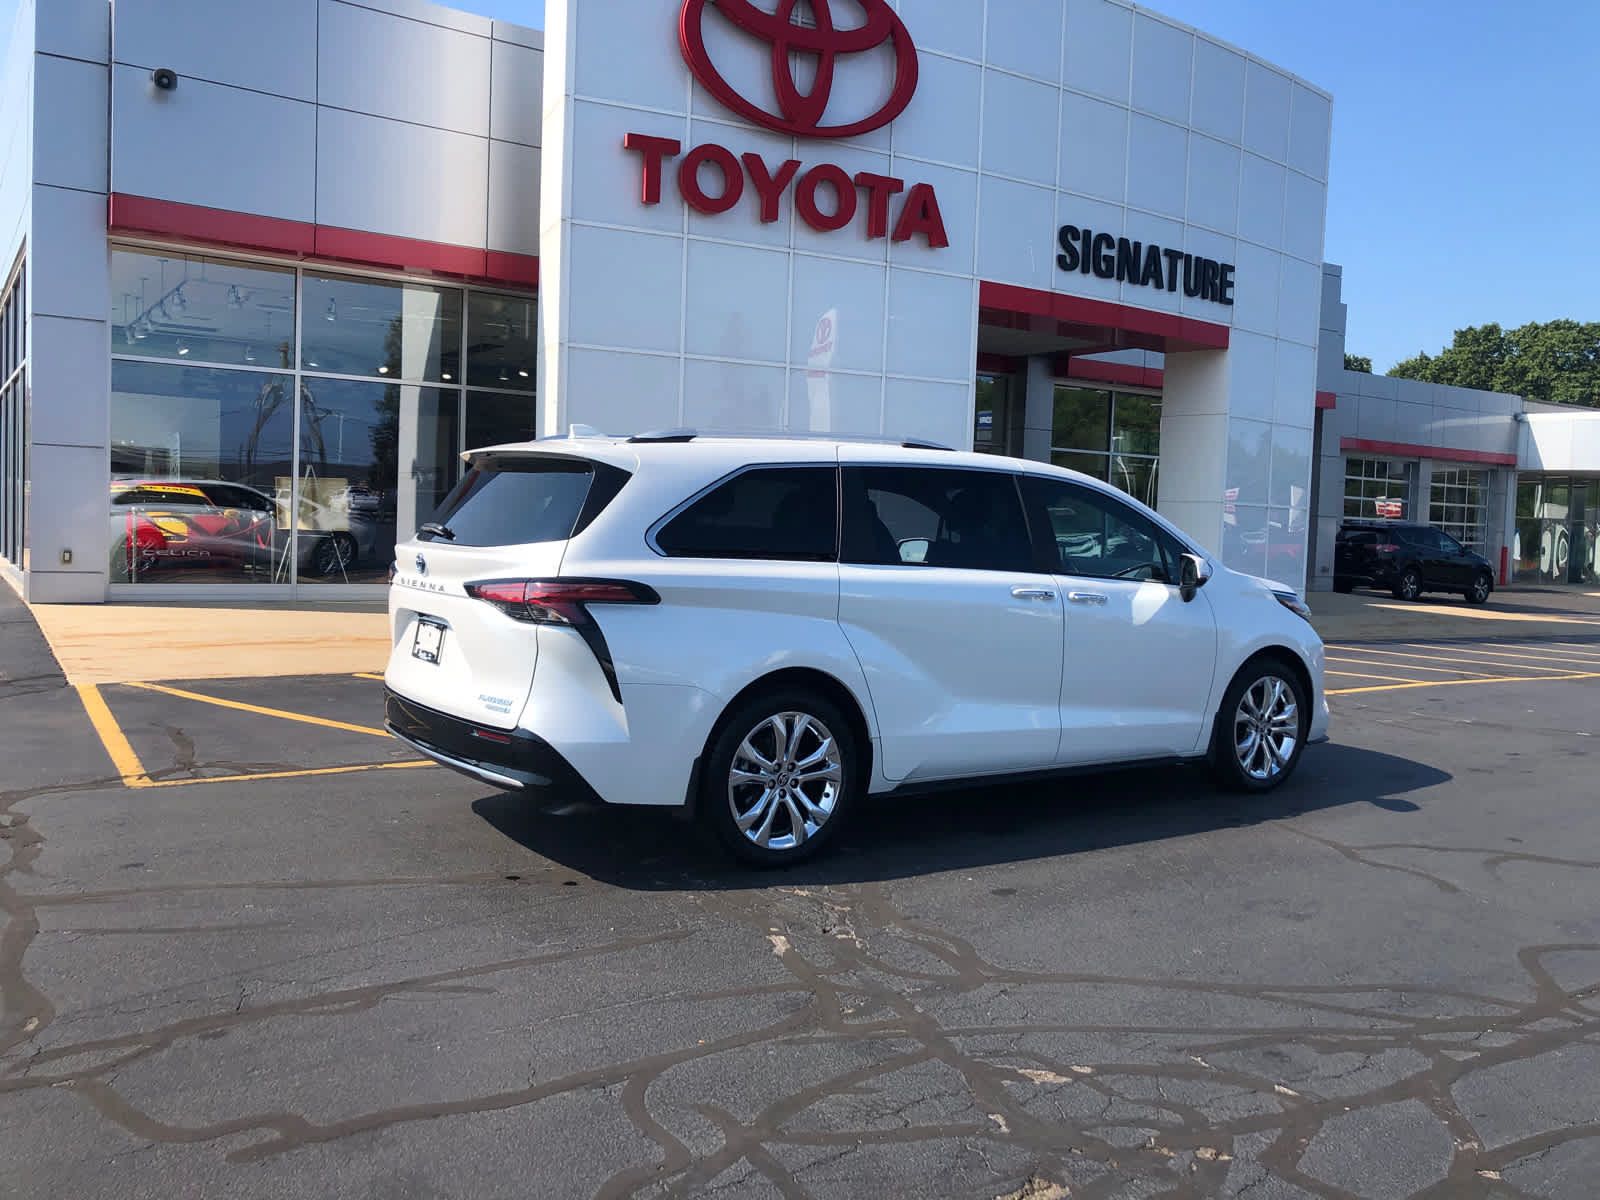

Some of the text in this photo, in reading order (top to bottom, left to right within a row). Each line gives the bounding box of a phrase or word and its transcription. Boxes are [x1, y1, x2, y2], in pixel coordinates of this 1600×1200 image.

[623, 132, 949, 248] TOYOTA
[1057, 224, 1236, 306] SIGNATURE
[142, 548, 211, 558] CELICA
[400, 577, 446, 592] SIENNA
